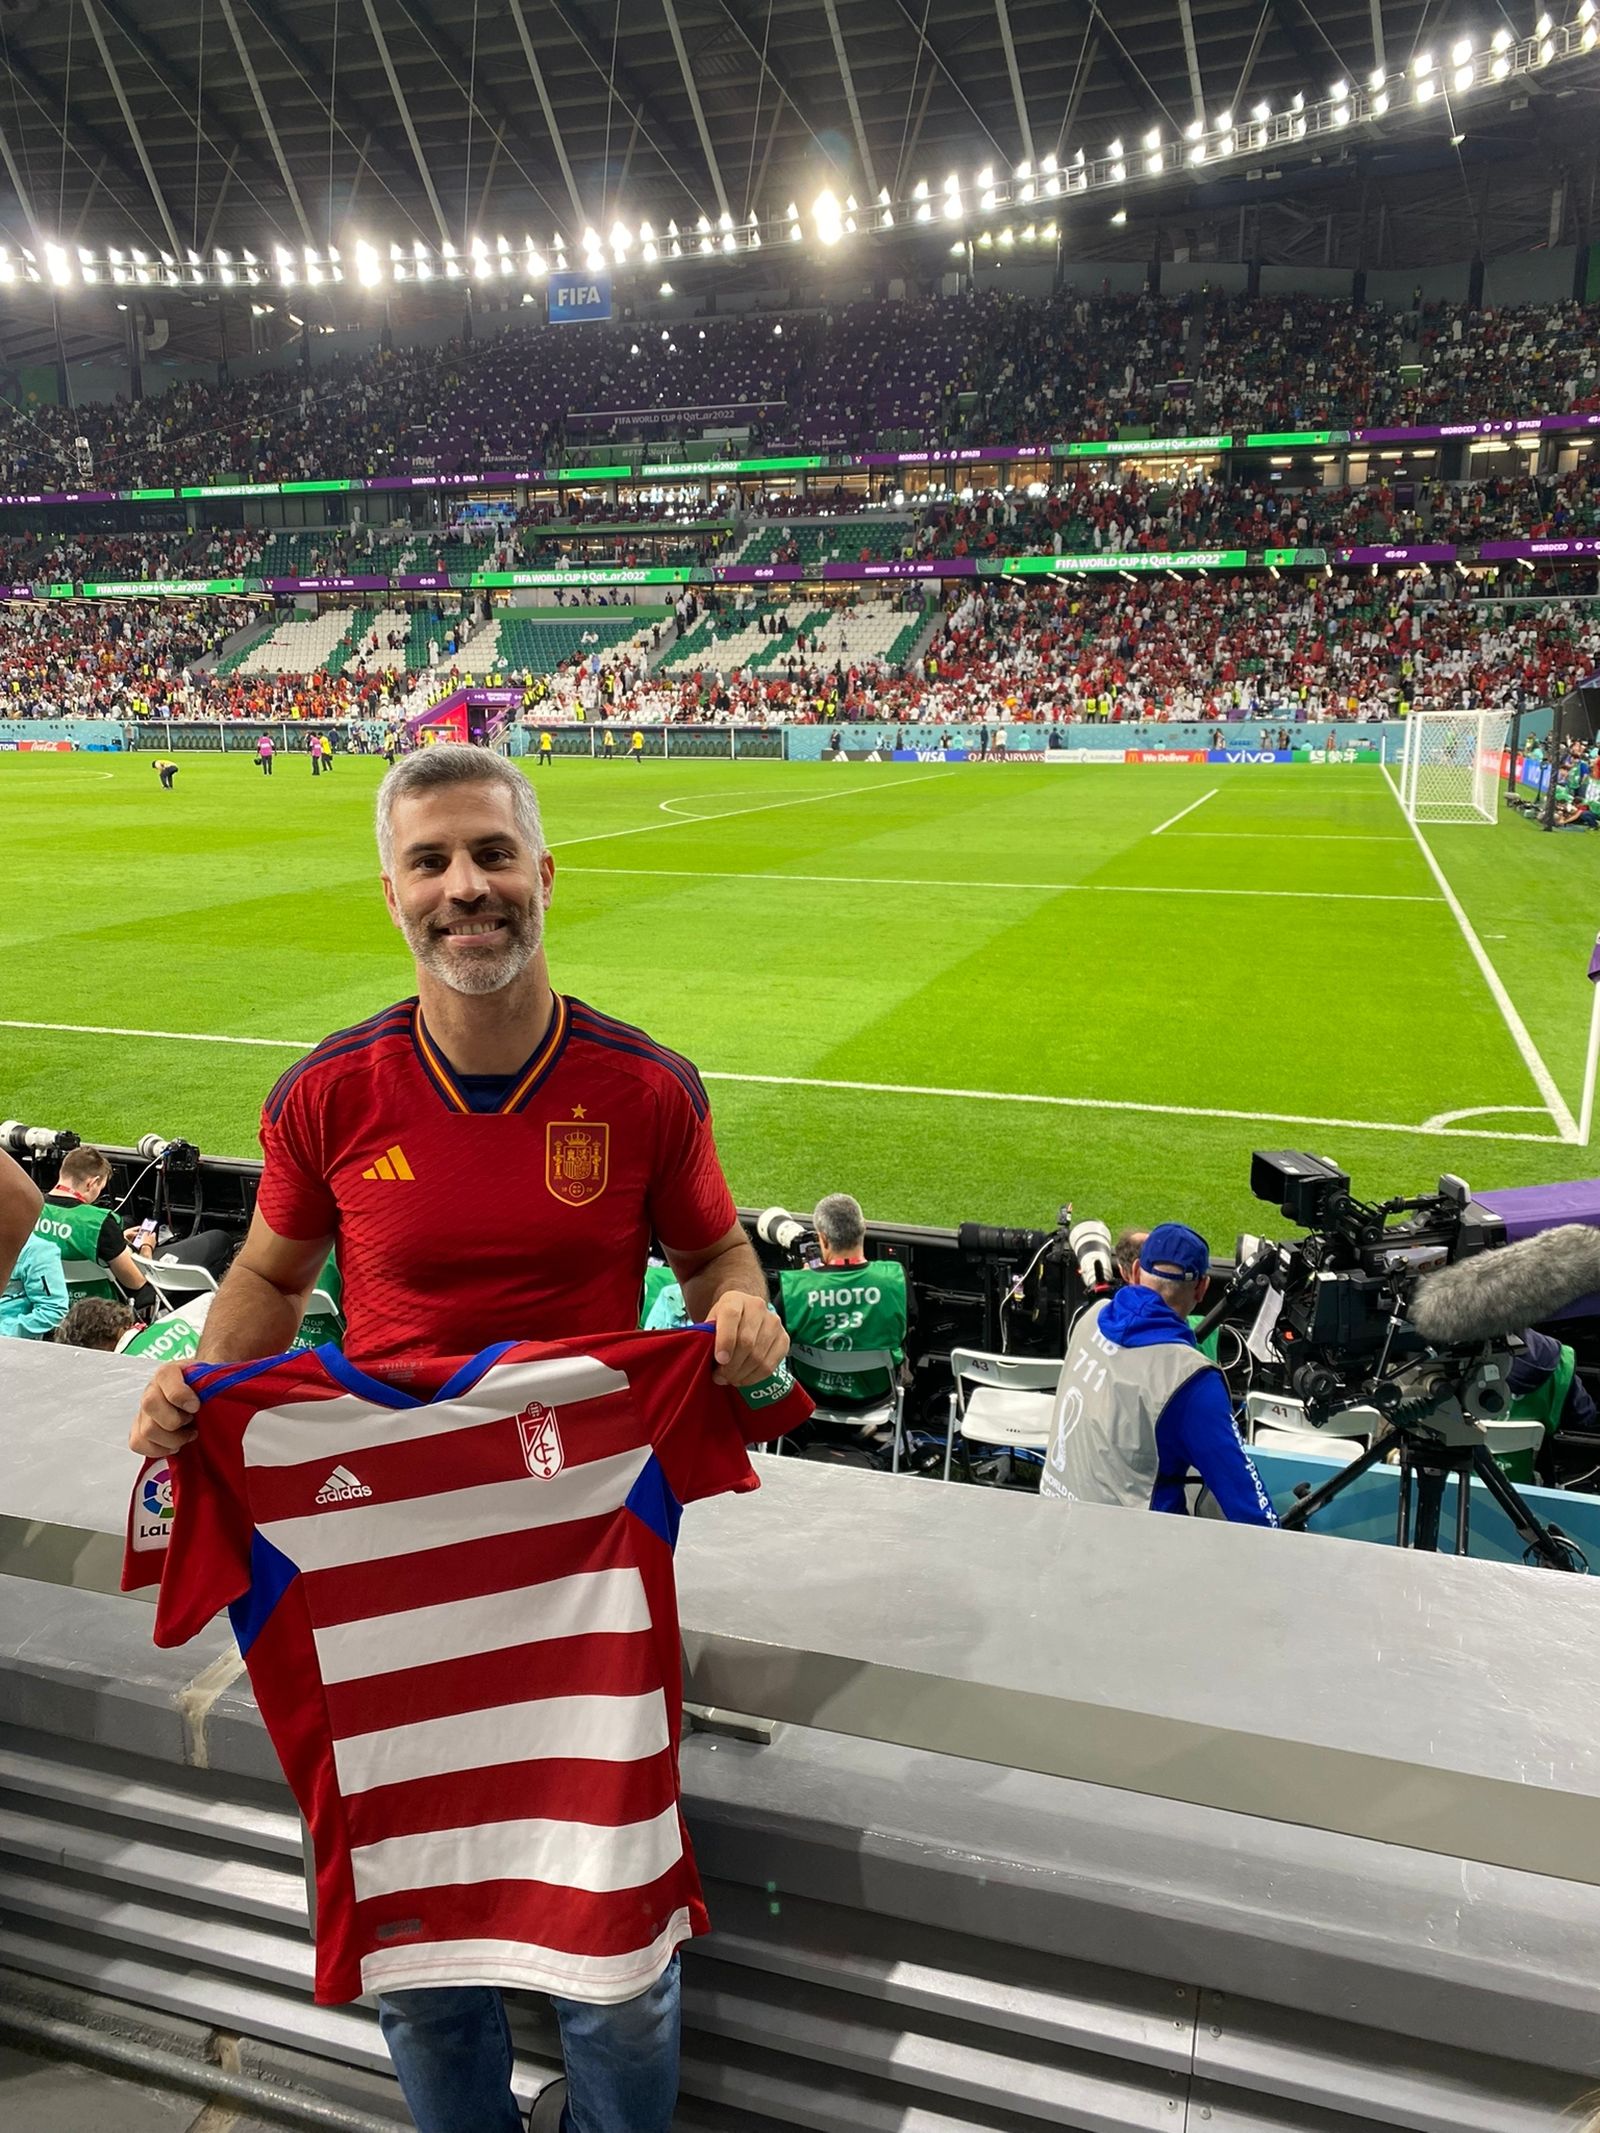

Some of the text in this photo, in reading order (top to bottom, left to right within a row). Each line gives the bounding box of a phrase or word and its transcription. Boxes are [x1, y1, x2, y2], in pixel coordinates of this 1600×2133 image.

[558, 286, 601, 306] FIFA
[1055, 559, 1079, 569] FIFA
[1079, 557, 1118, 568] WORLD
[1119, 557, 1140, 567] CUP
[513, 574, 532, 584] FIFA
[532, 573, 563, 583] WORLD
[564, 573, 581, 582] CUP
[96, 585, 112, 594] FIFA
[112, 584, 138, 594] WORLD
[139, 584, 154, 593] CUP
[915, 751, 947, 763] VISA
[1004, 752, 1046, 763] AIRWAYS
[1142, 752, 1190, 762] We Deliver
[34, 1217, 73, 1240] OTO
[807, 1286, 882, 1309] PHOTO
[823, 1310, 864, 1330] 333
[971, 1359, 989, 1372] 43
[750, 1382, 783, 1400] CAJA
[1272, 1405, 1289, 1418] 41
[315, 1485, 373, 1505] adidas
